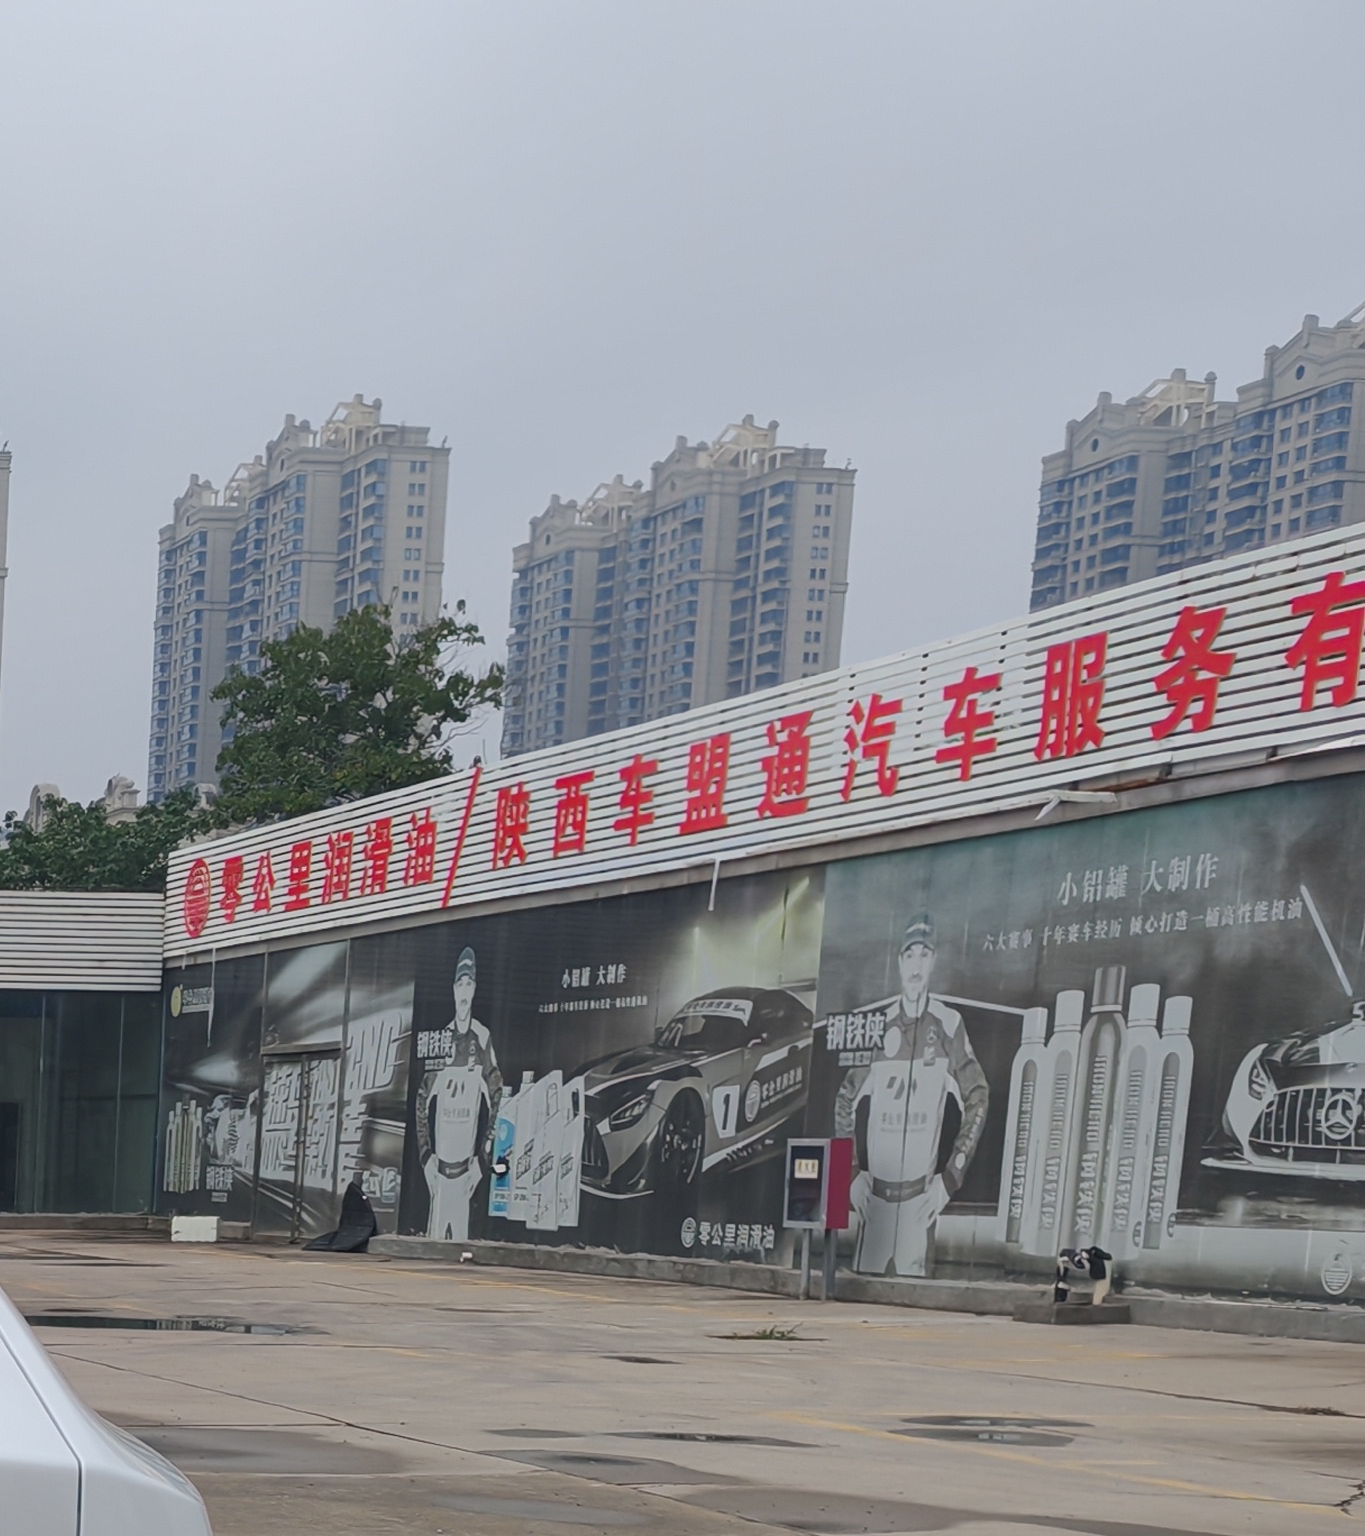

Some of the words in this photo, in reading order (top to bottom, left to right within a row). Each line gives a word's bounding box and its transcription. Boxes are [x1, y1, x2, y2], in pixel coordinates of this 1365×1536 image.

[218, 810, 439, 924] 零公里润滑油
[1141, 852, 1220, 894] 大制作
[826, 1011, 885, 1051] 钢铁侠
